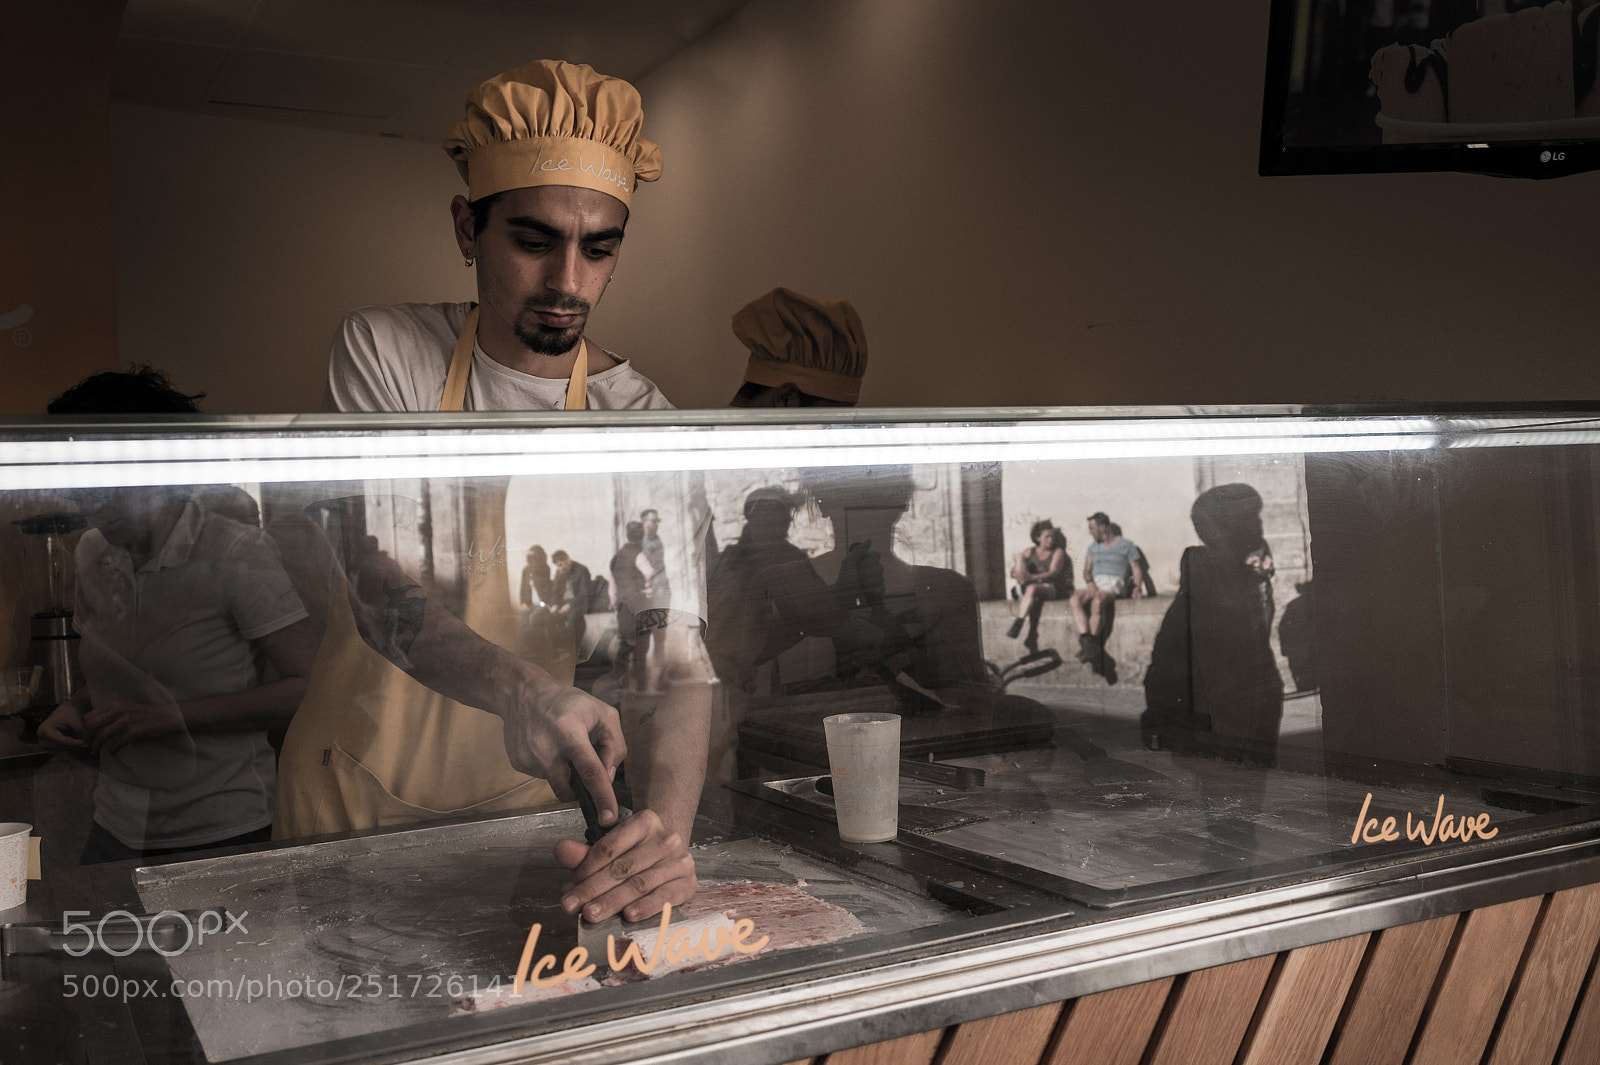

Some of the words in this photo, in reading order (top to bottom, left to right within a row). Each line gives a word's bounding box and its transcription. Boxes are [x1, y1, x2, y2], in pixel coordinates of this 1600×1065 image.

[530, 146, 574, 174] Ice
[579, 154, 630, 193] Wave
[1351, 792, 1400, 845] Ice
[1406, 793, 1499, 846] Wave
[512, 922, 597, 996] Ice
[607, 901, 770, 975] Wave
